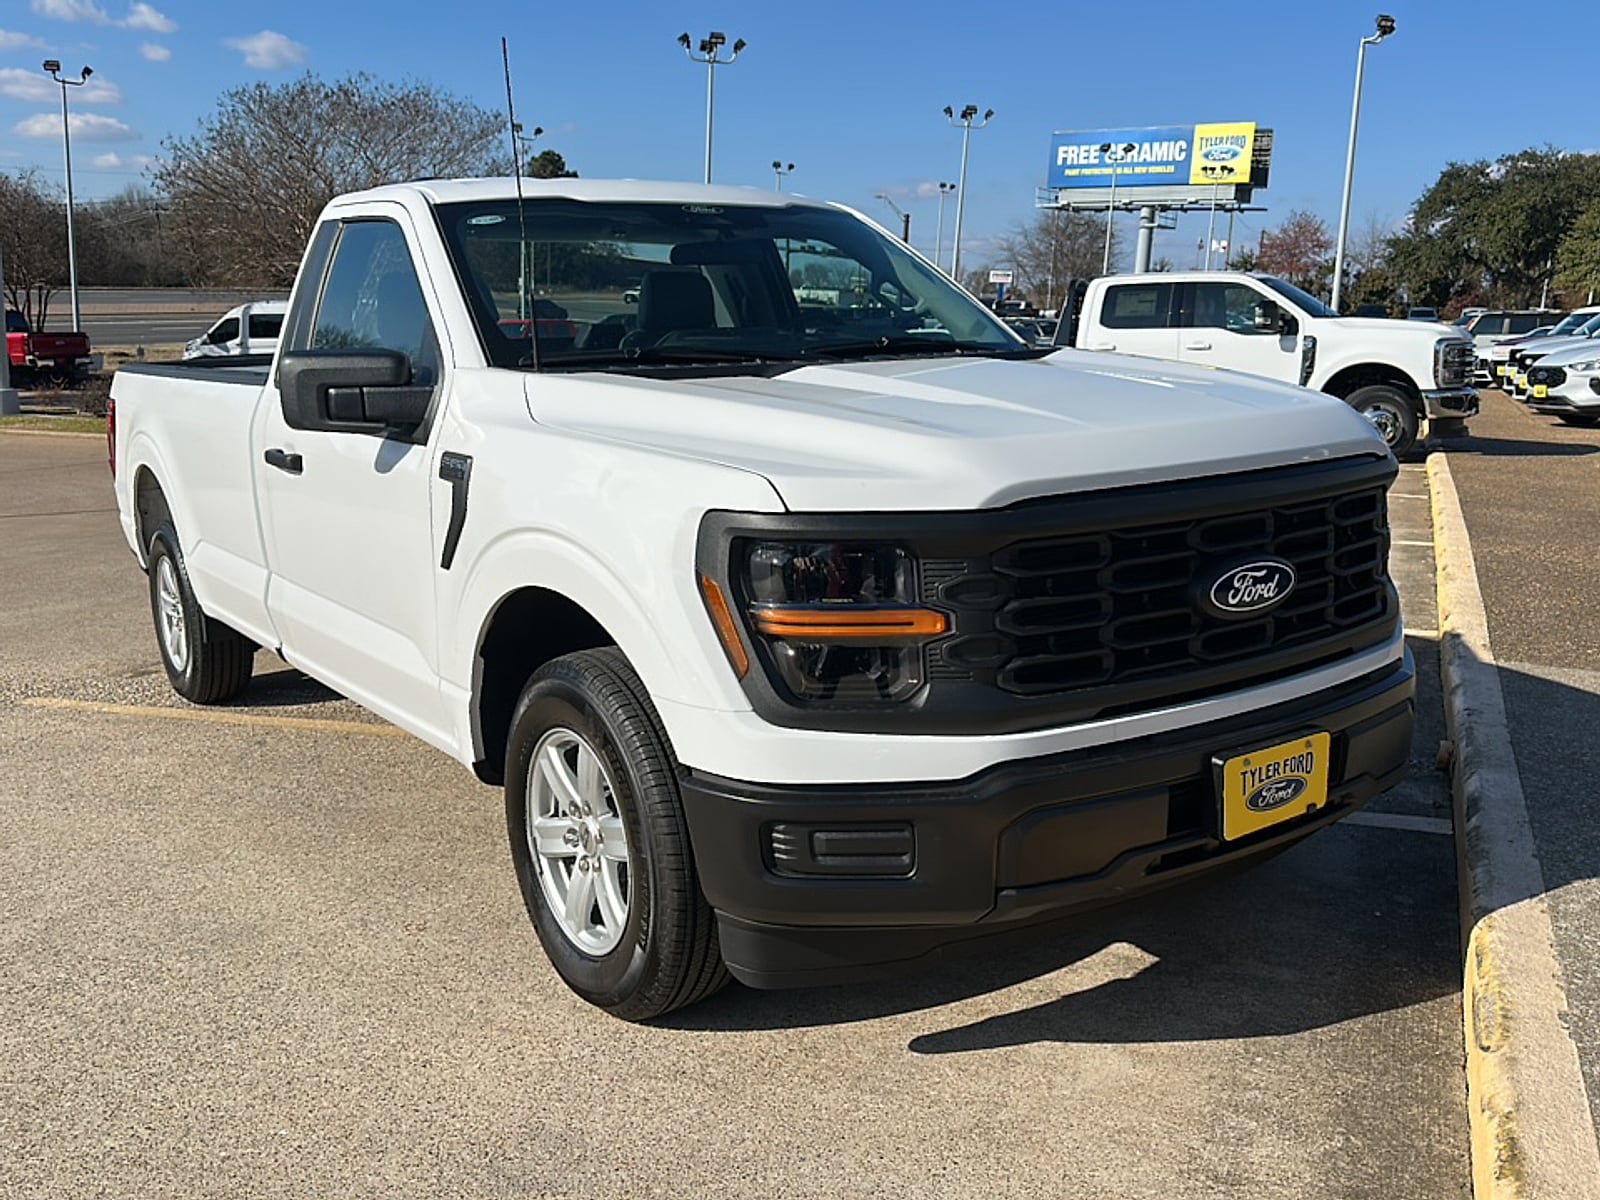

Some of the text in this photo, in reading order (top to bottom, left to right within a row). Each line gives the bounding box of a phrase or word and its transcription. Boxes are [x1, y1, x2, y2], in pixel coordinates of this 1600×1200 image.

[1057, 143, 1101, 165] FREE
[1200, 136, 1224, 151] TYLER
[1228, 569, 1280, 605] Ford
[1240, 751, 1315, 797] TYLER FORD
[1258, 781, 1297, 807] Ford
